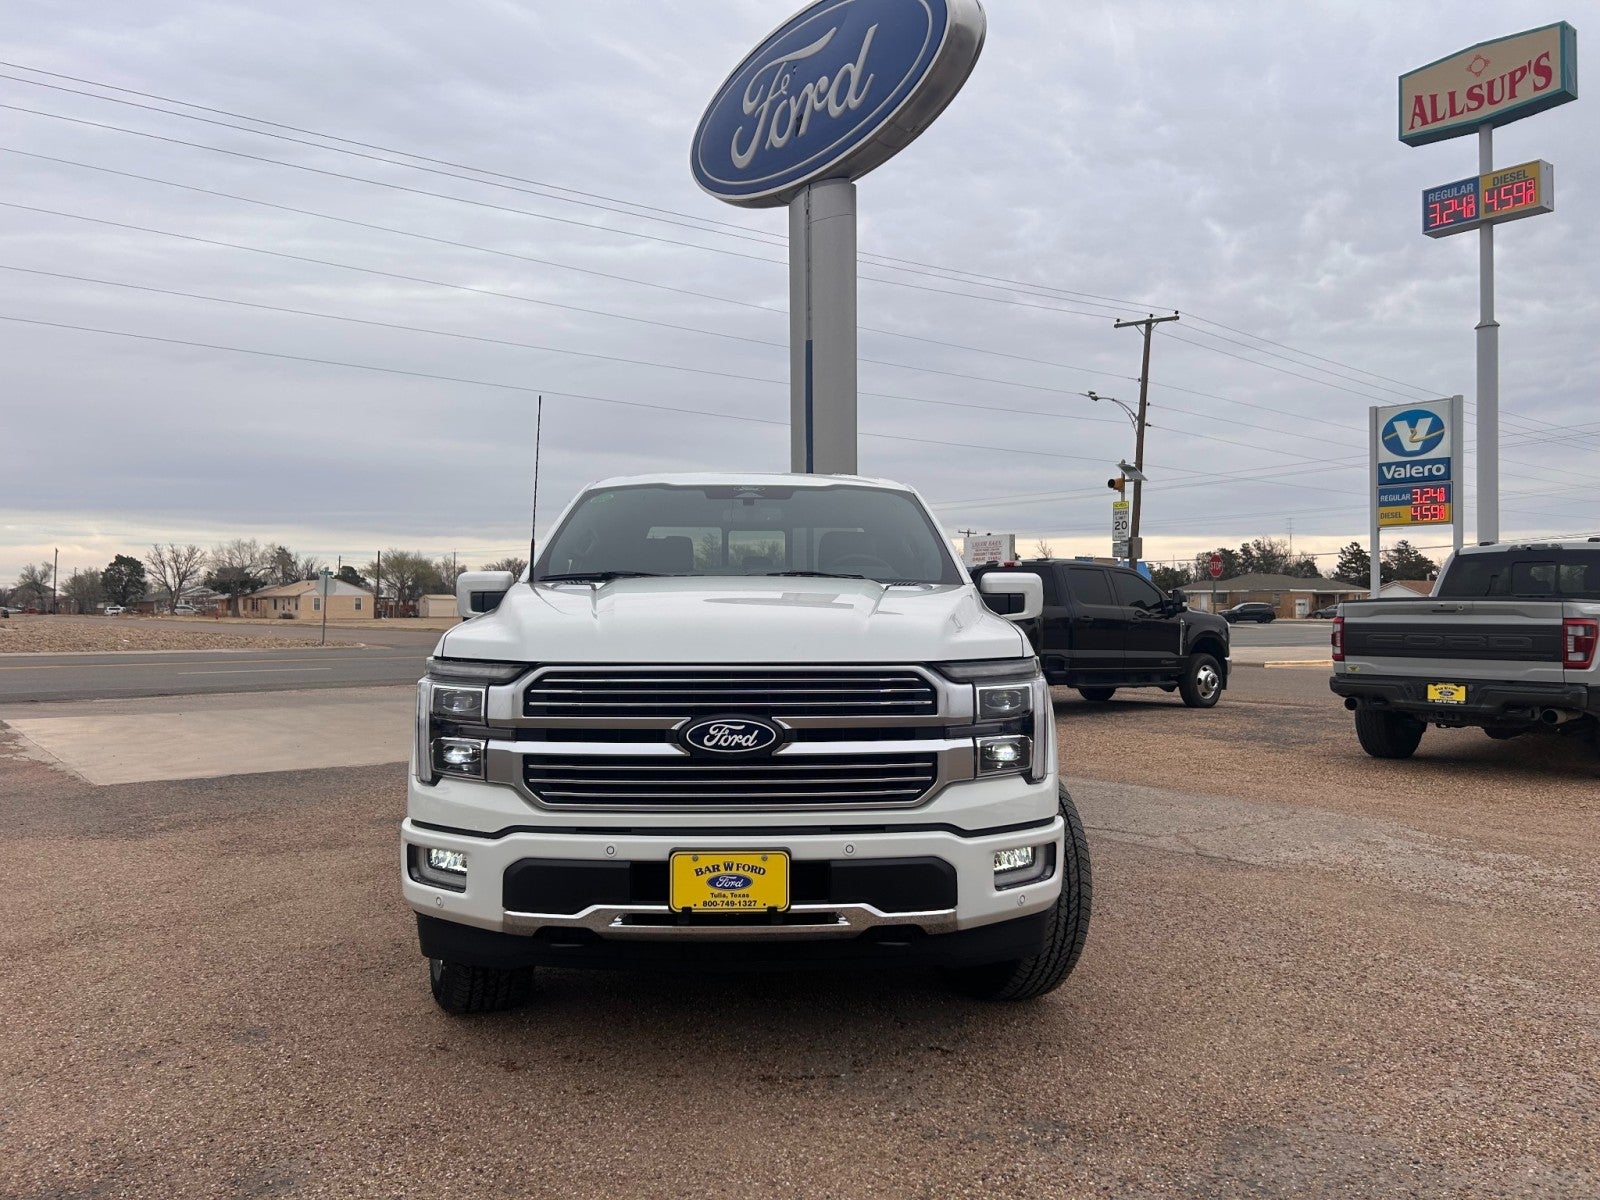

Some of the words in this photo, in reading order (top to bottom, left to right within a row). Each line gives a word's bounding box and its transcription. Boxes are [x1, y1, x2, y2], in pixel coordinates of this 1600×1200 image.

[731, 23, 879, 169] Ford
[1408, 51, 1553, 131] ALLSUP'S
[1492, 169, 1529, 187] DIESEL
[1428, 183, 1474, 203] REGULAR
[1381, 464, 1445, 480] Valero
[1380, 493, 1411, 502] REGULAR
[1380, 511, 1403, 519] DIESEL
[1114, 521, 1128, 530] 20
[1210, 562, 1222, 570] STOP
[703, 724, 759, 746] Ford
[694, 864, 721, 877] BAR
[723, 861, 734, 872] W
[736, 863, 766, 876] FORD
[716, 876, 744, 888] Ford
